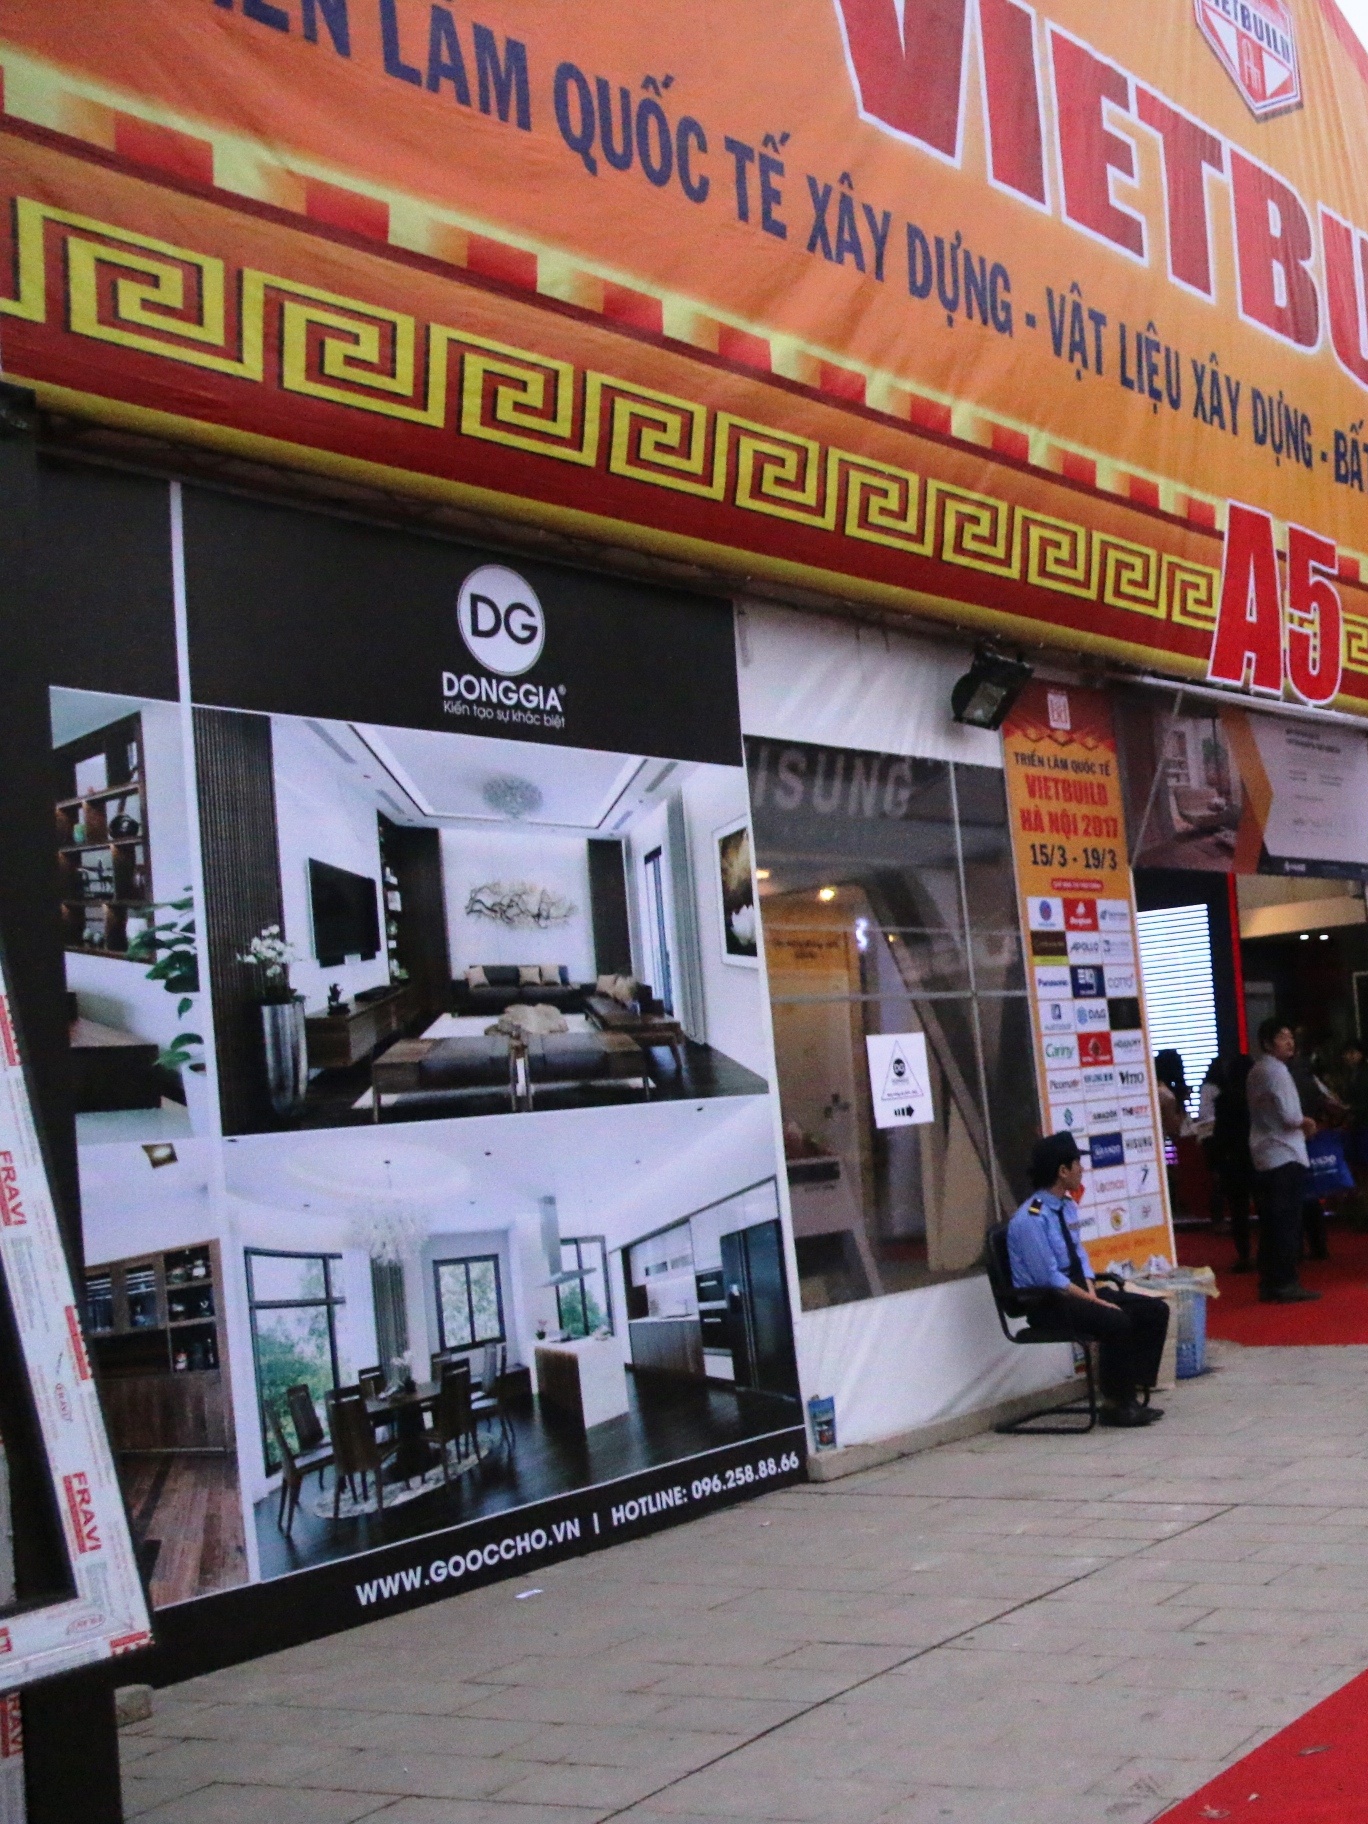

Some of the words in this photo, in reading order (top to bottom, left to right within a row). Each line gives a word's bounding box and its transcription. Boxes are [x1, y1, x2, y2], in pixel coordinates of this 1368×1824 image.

[553, 62, 709, 204] QUỐC
[724, 131, 791, 240] TẾ
[806, 171, 891, 282] XÂY
[906, 222, 1013, 337] DỰNG
[1046, 282, 1107, 382] VẬT
[1119, 320, 1182, 414] LIỆU
[1191, 352, 1240, 436] XÂY
[1252, 388, 1313, 470] DỰNG
[470, 593, 538, 645] DG
[1206, 499, 1342, 705] A5
[442, 671, 563, 712] DONGGIA
[443, 700, 470, 716] Kiến
[473, 704, 494, 721] tạo
[497, 708, 509, 723] sự
[512, 709, 541, 725] khác
[543, 715, 565, 730] biệt
[744, 743, 912, 819] ISUNG
[1024, 774, 1109, 807] VIETBUILD
[1019, 804, 1046, 833] HÀ
[1048, 809, 1079, 840] NỘI
[1081, 814, 1119, 839] 2017
[1030, 843, 1067, 868] 15/3
[1083, 847, 1118, 871] 19/3
[0, 1150, 27, 1226] FRAVI
[72, 1471, 102, 1552] FRAVI
[355, 1517, 580, 1606] WWW.GOOCCHO.VN
[612, 1486, 688, 1527] HOTLINE:
[691, 1450, 800, 1499] 096.258.88.66
